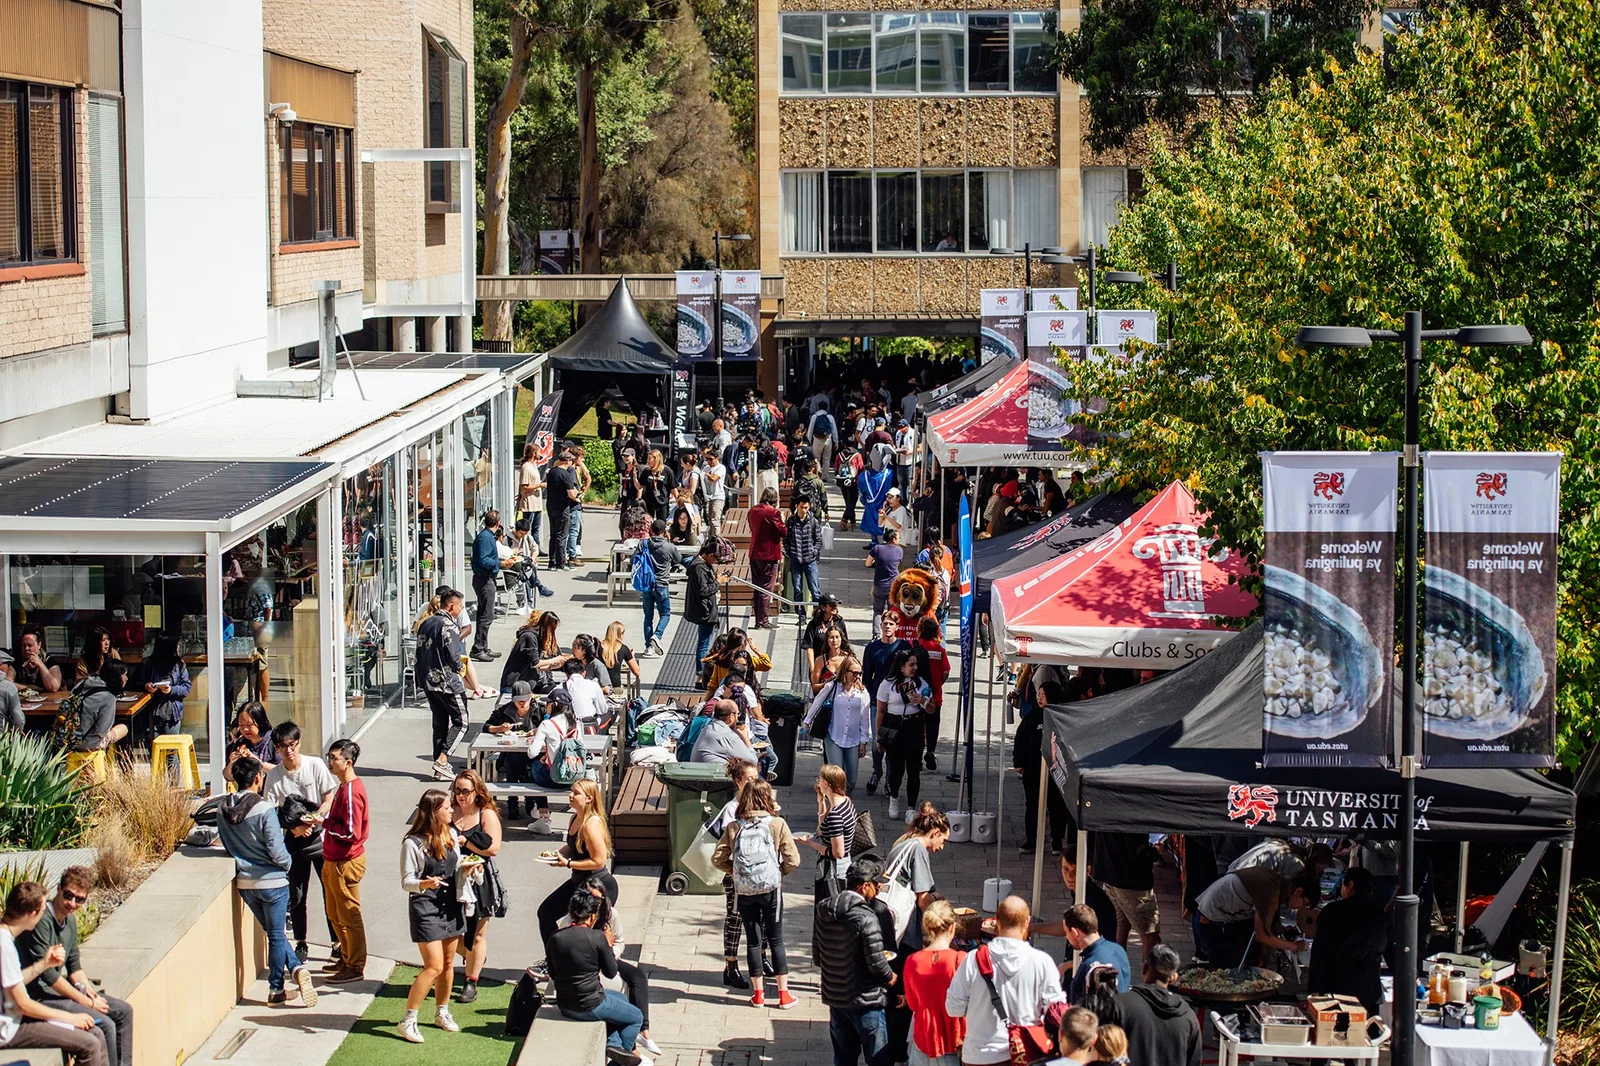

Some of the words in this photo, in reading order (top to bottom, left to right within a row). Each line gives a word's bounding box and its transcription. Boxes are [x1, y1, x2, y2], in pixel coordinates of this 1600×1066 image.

[675, 391, 688, 401] Life
[1112, 641, 1162, 658] Clubs
[1166, 643, 1180, 659] &
[1285, 790, 1417, 810] UNIVERSIT
[1285, 809, 1431, 831] TASMANA
